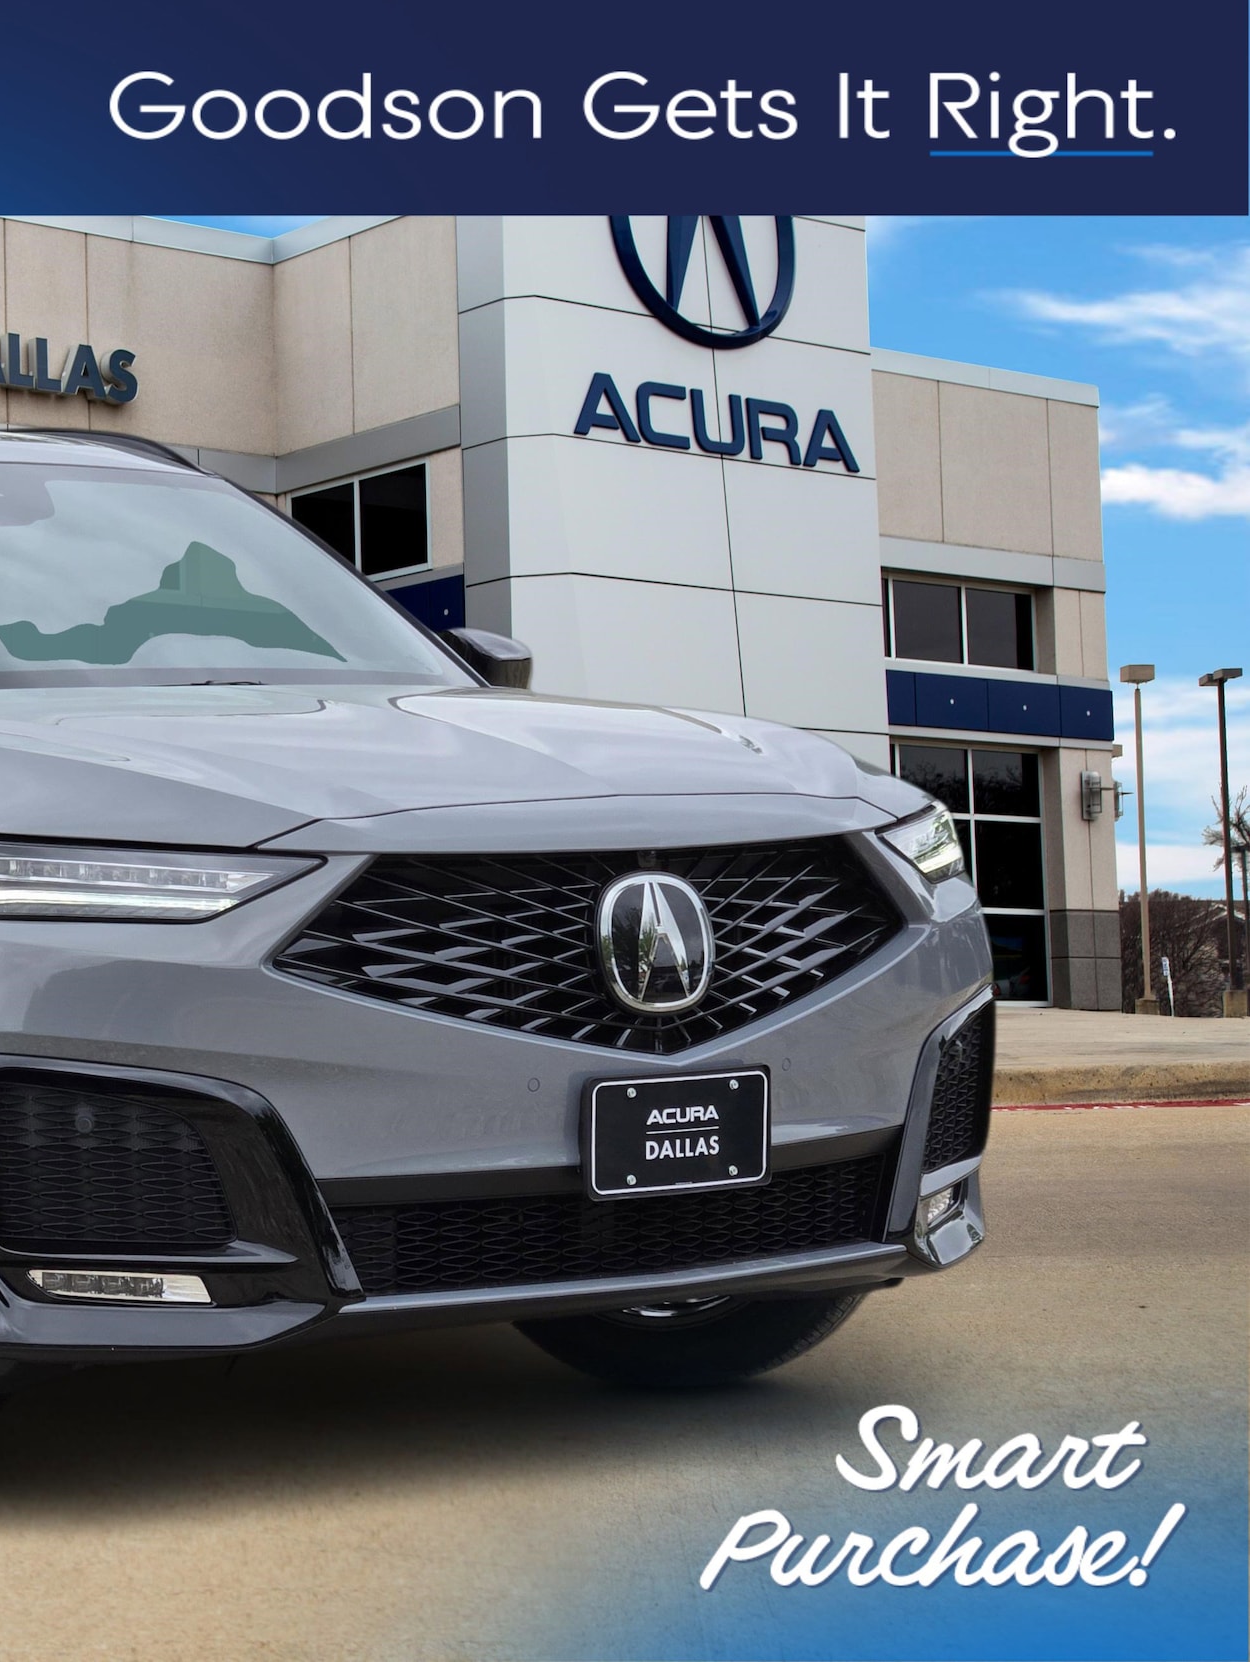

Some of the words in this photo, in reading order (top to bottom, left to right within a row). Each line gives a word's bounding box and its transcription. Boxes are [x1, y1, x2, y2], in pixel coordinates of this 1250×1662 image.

[573, 371, 860, 475] ACURA
[646, 1104, 720, 1126] ACURA
[645, 1135, 720, 1161] DALLAS
